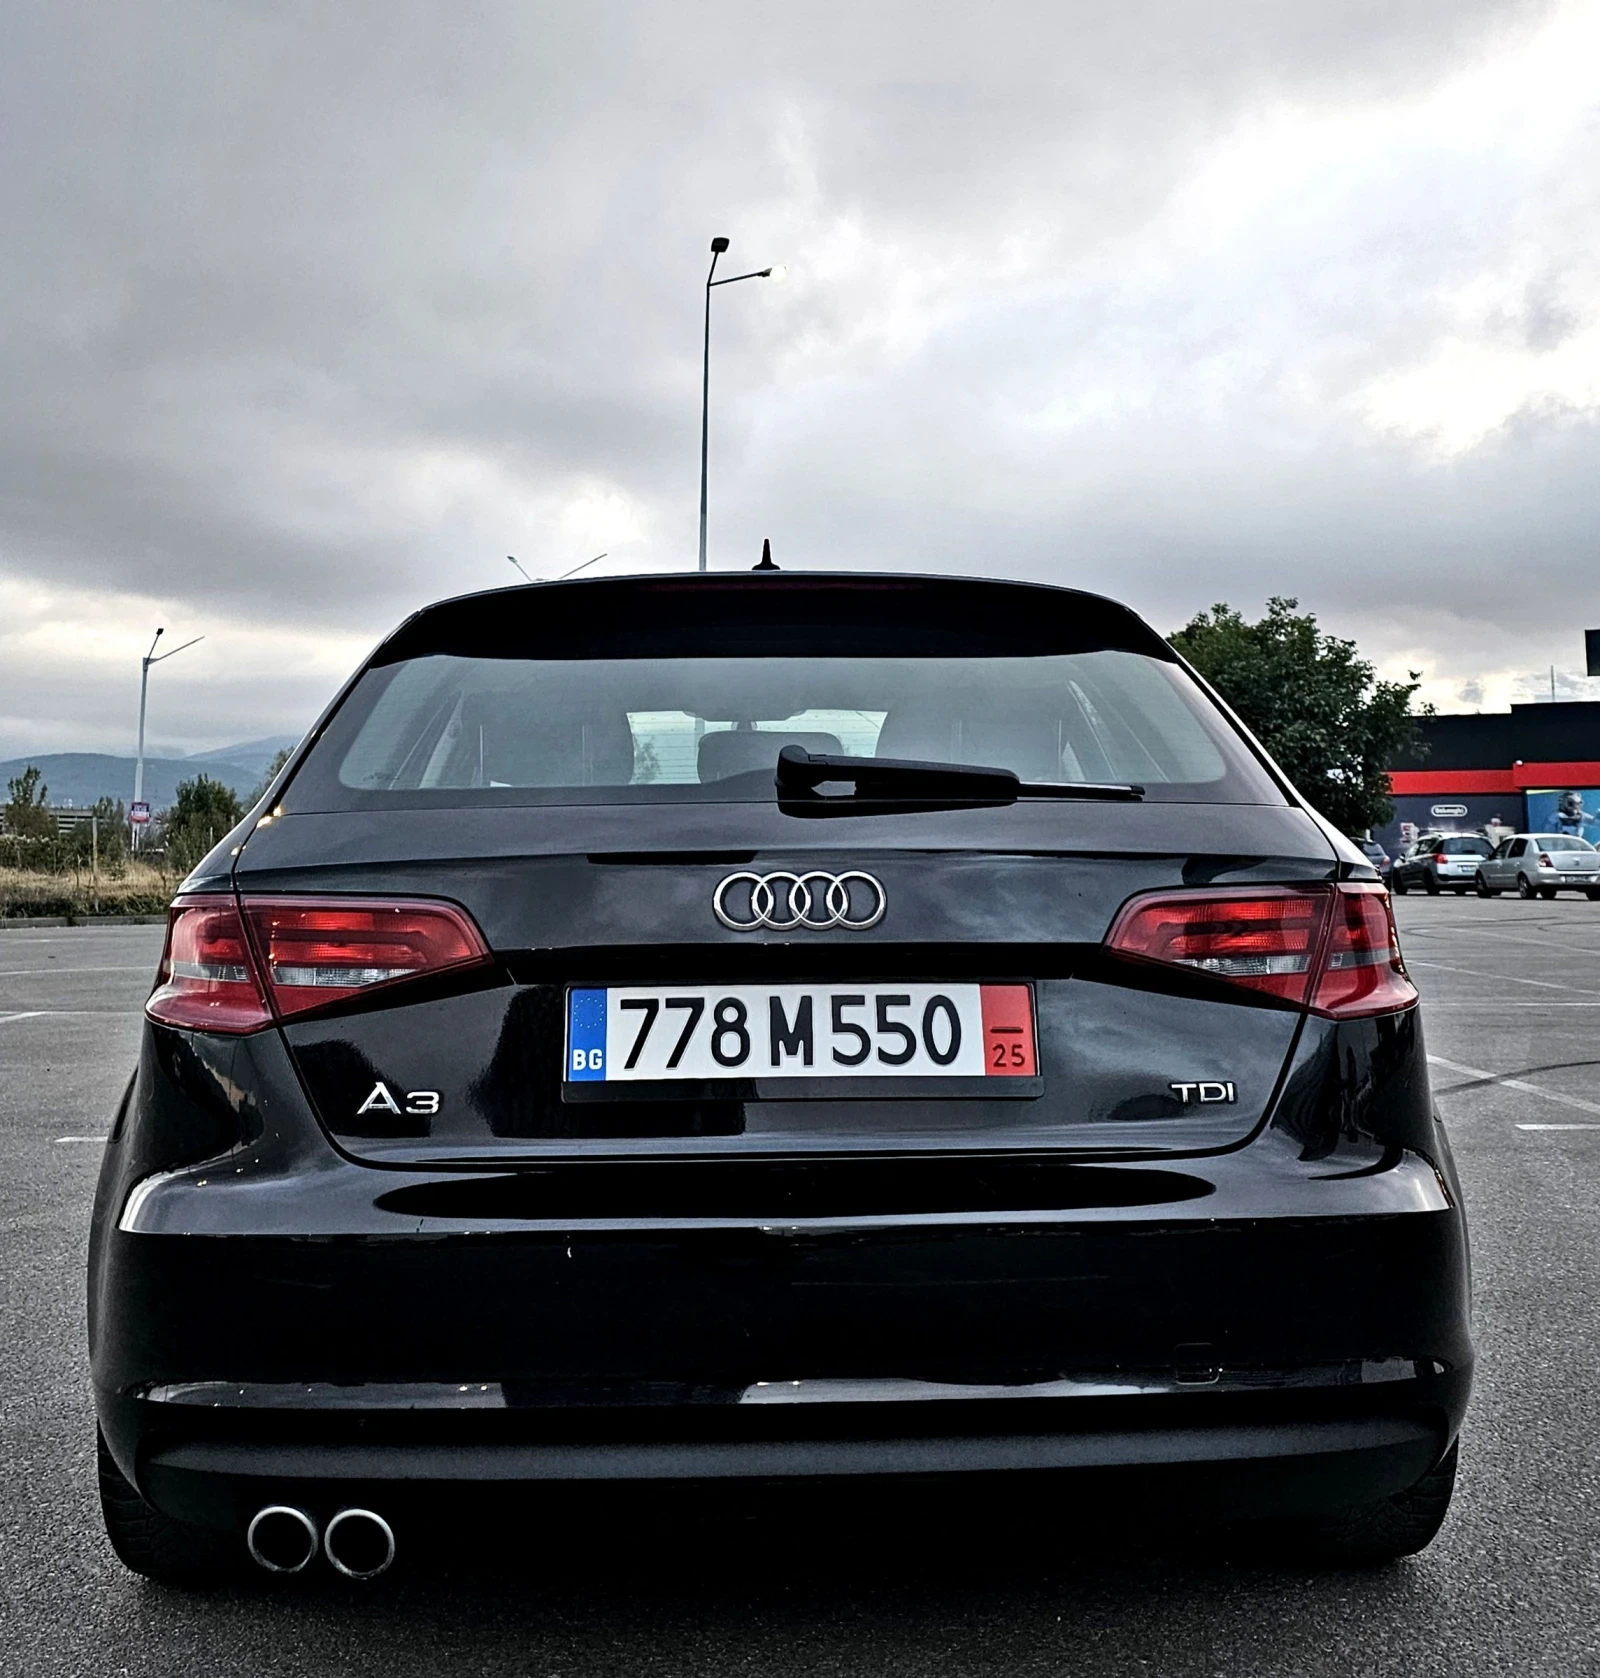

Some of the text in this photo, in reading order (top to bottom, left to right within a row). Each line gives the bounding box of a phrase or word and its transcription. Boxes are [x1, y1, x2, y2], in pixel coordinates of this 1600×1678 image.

[620, 995, 962, 1069] 778 M 550
[572, 1048, 602, 1071] BG
[992, 1043, 1025, 1068] 25
[356, 1082, 440, 1115] A3
[1170, 1082, 1235, 1103] TDI
